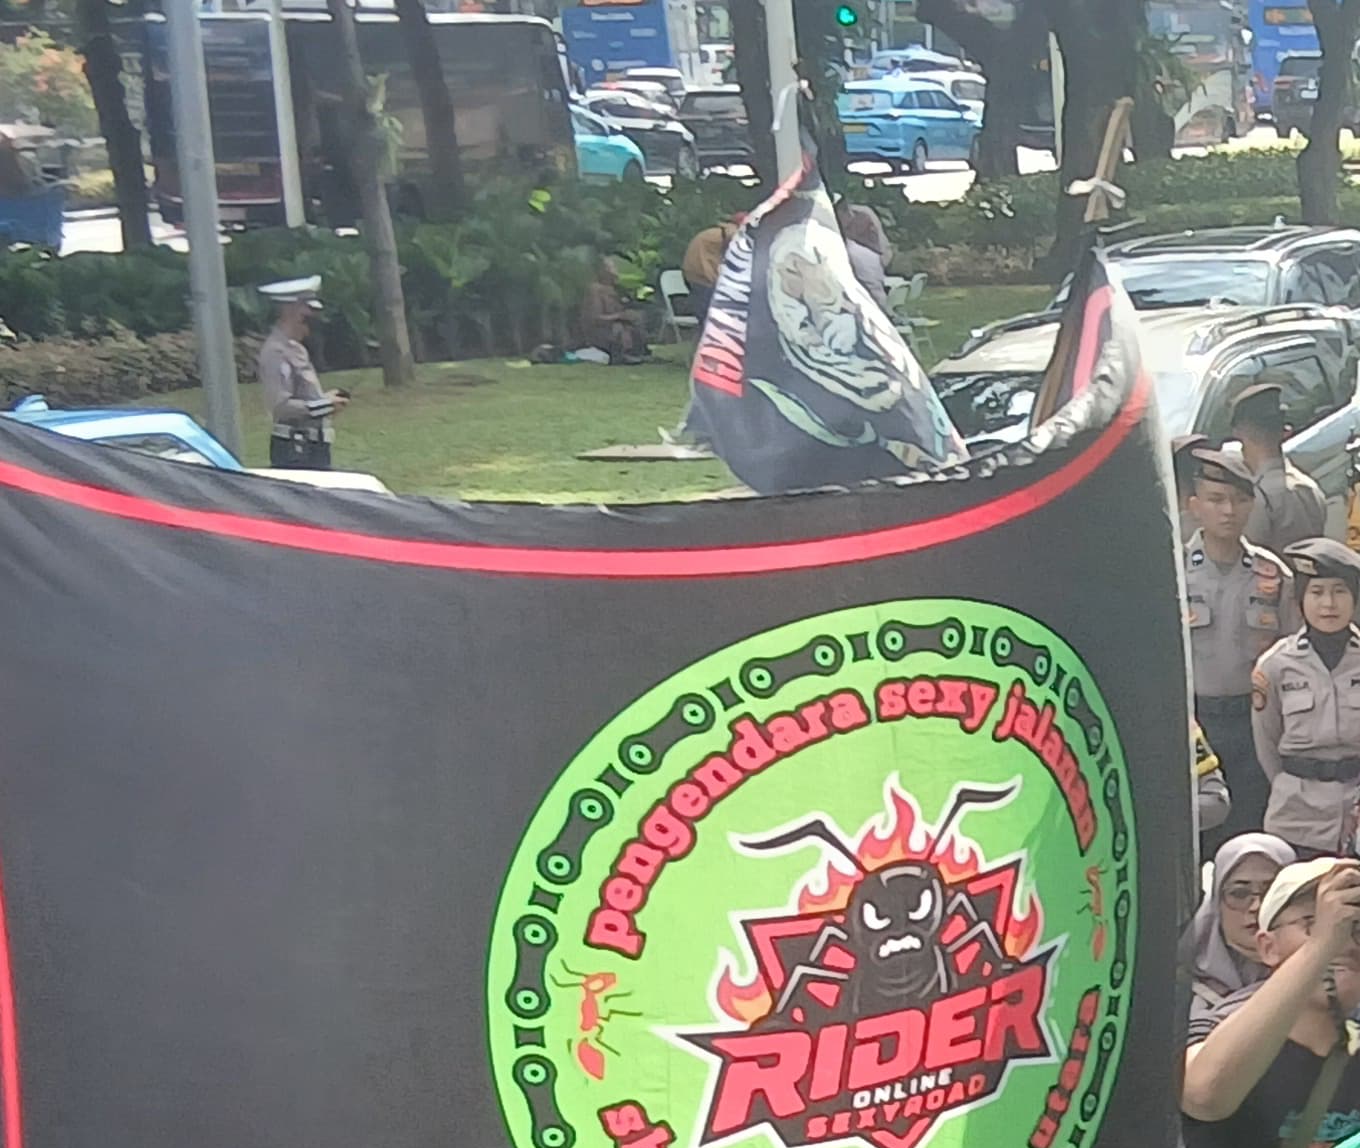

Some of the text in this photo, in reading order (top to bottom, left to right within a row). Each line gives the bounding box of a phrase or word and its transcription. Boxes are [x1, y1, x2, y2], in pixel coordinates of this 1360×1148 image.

[584, 676, 1097, 957] pengendara sexy jalanan
[713, 965, 1044, 1131] RIDER
[851, 1068, 955, 1111] ONLINE
[806, 1076, 985, 1140] SEXYROAD
